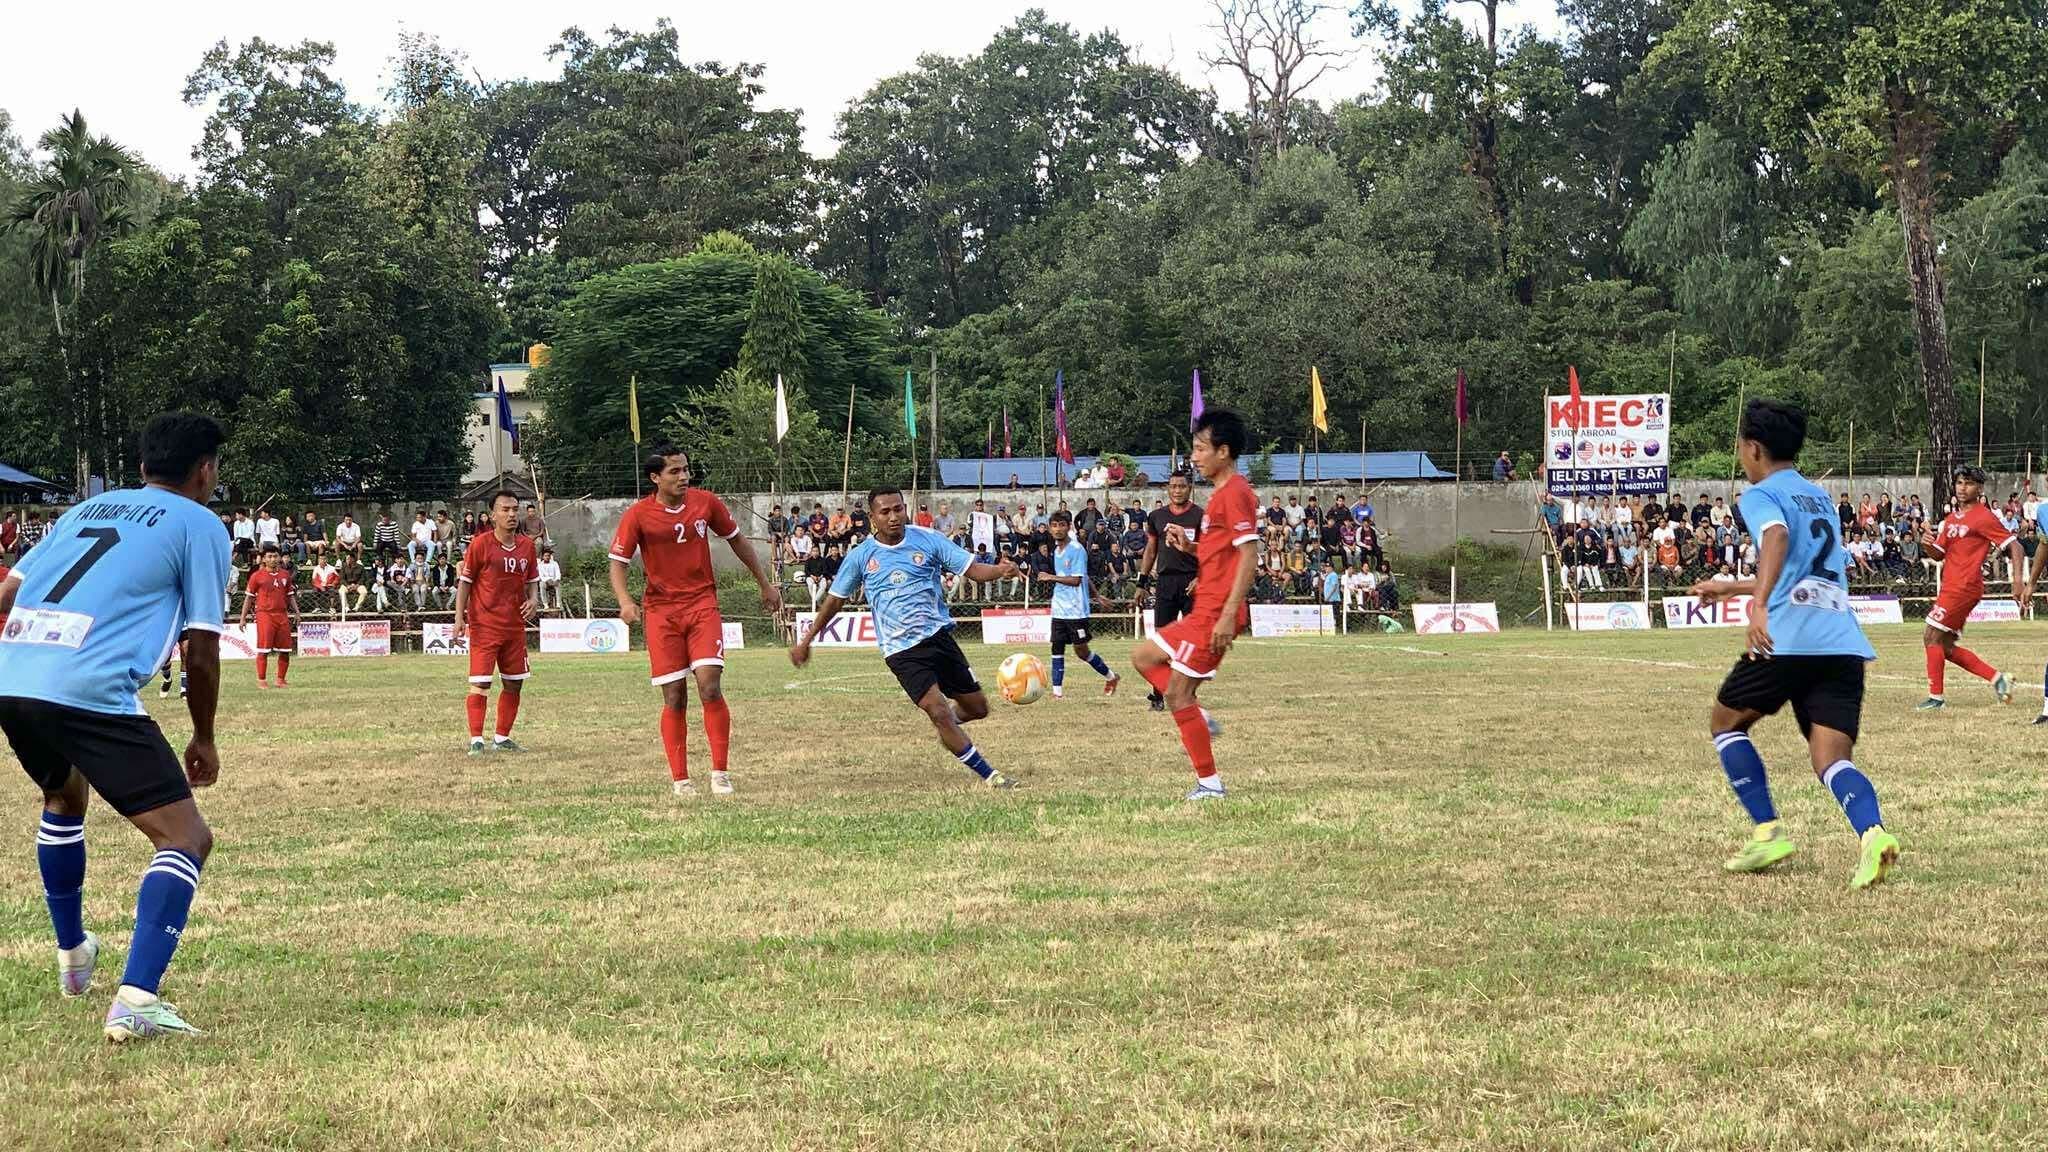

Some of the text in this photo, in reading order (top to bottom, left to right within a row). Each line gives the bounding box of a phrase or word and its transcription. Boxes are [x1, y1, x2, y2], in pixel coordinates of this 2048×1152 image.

[1551, 400, 1644, 428] KIEC
[1551, 429, 1617, 437] STUD ABROAD
[1552, 468, 1663, 481] IELTS PTE SAT
[137, 505, 167, 527] FC
[674, 523, 687, 543] 2
[1810, 518, 1840, 582] 2
[41, 527, 121, 605] 7
[503, 557, 517, 573] 19
[818, 617, 877, 642] KIE
[716, 640, 723, 658] 2
[1174, 640, 1195, 663] 11
[165, 925, 183, 939] SPO
